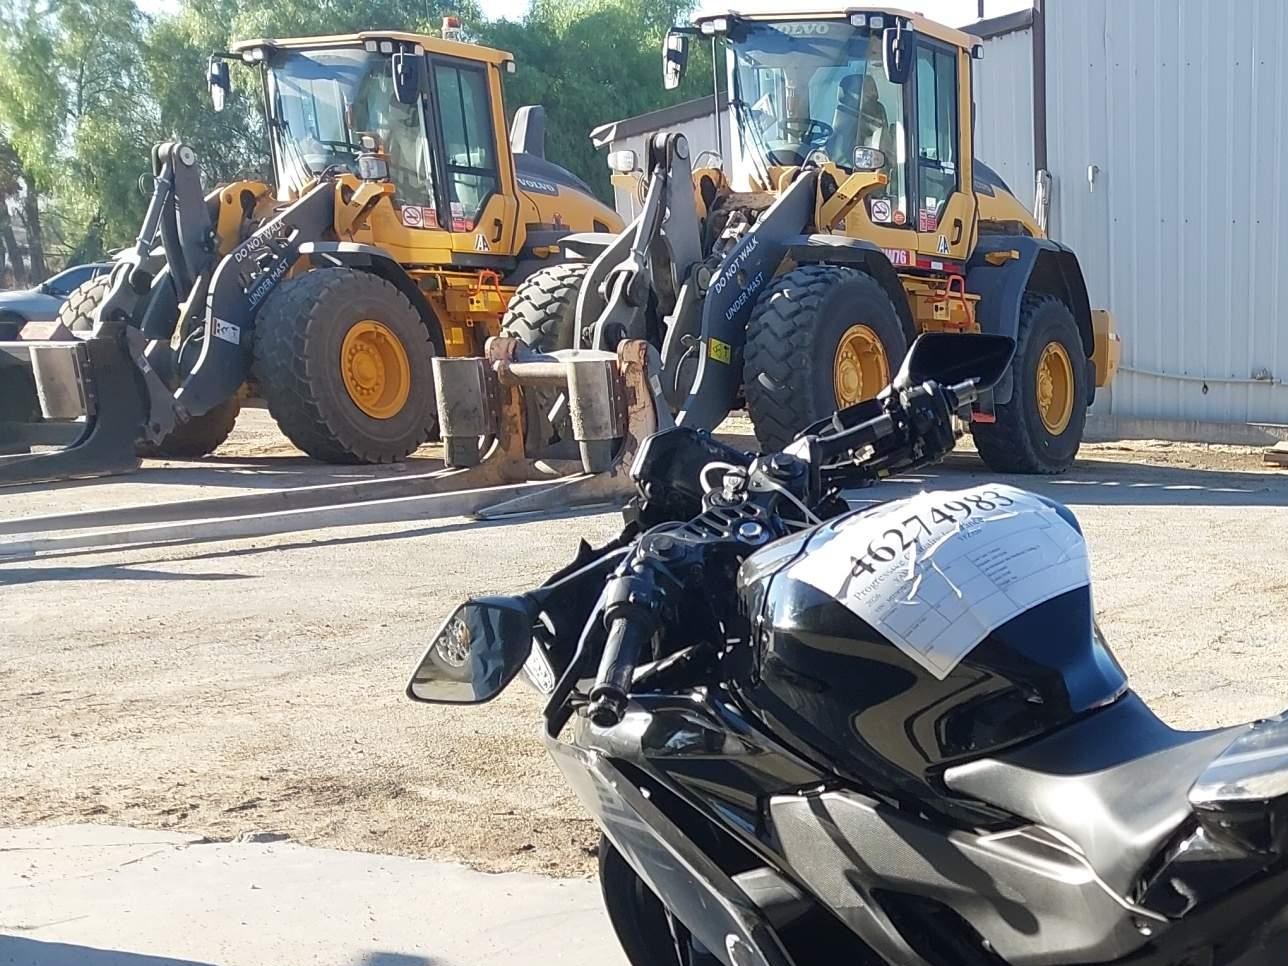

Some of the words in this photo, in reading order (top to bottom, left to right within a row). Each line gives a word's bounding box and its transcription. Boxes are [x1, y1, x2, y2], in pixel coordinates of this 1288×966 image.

[777, 23, 829, 34] OLVO
[517, 177, 555, 192] VOLVO
[235, 248, 248, 263] DO
[247, 235, 264, 251] NOT
[262, 220, 285, 240] WALK
[715, 276, 727, 295] DO
[725, 258, 741, 281] NOT
[739, 235, 760, 262] WALK
[248, 278, 273, 306] UNDER
[271, 258, 290, 281] MAST
[725, 292, 748, 321] UNDER
[747, 271, 765, 297] MAST
[851, 491, 1014, 578] 46274983
